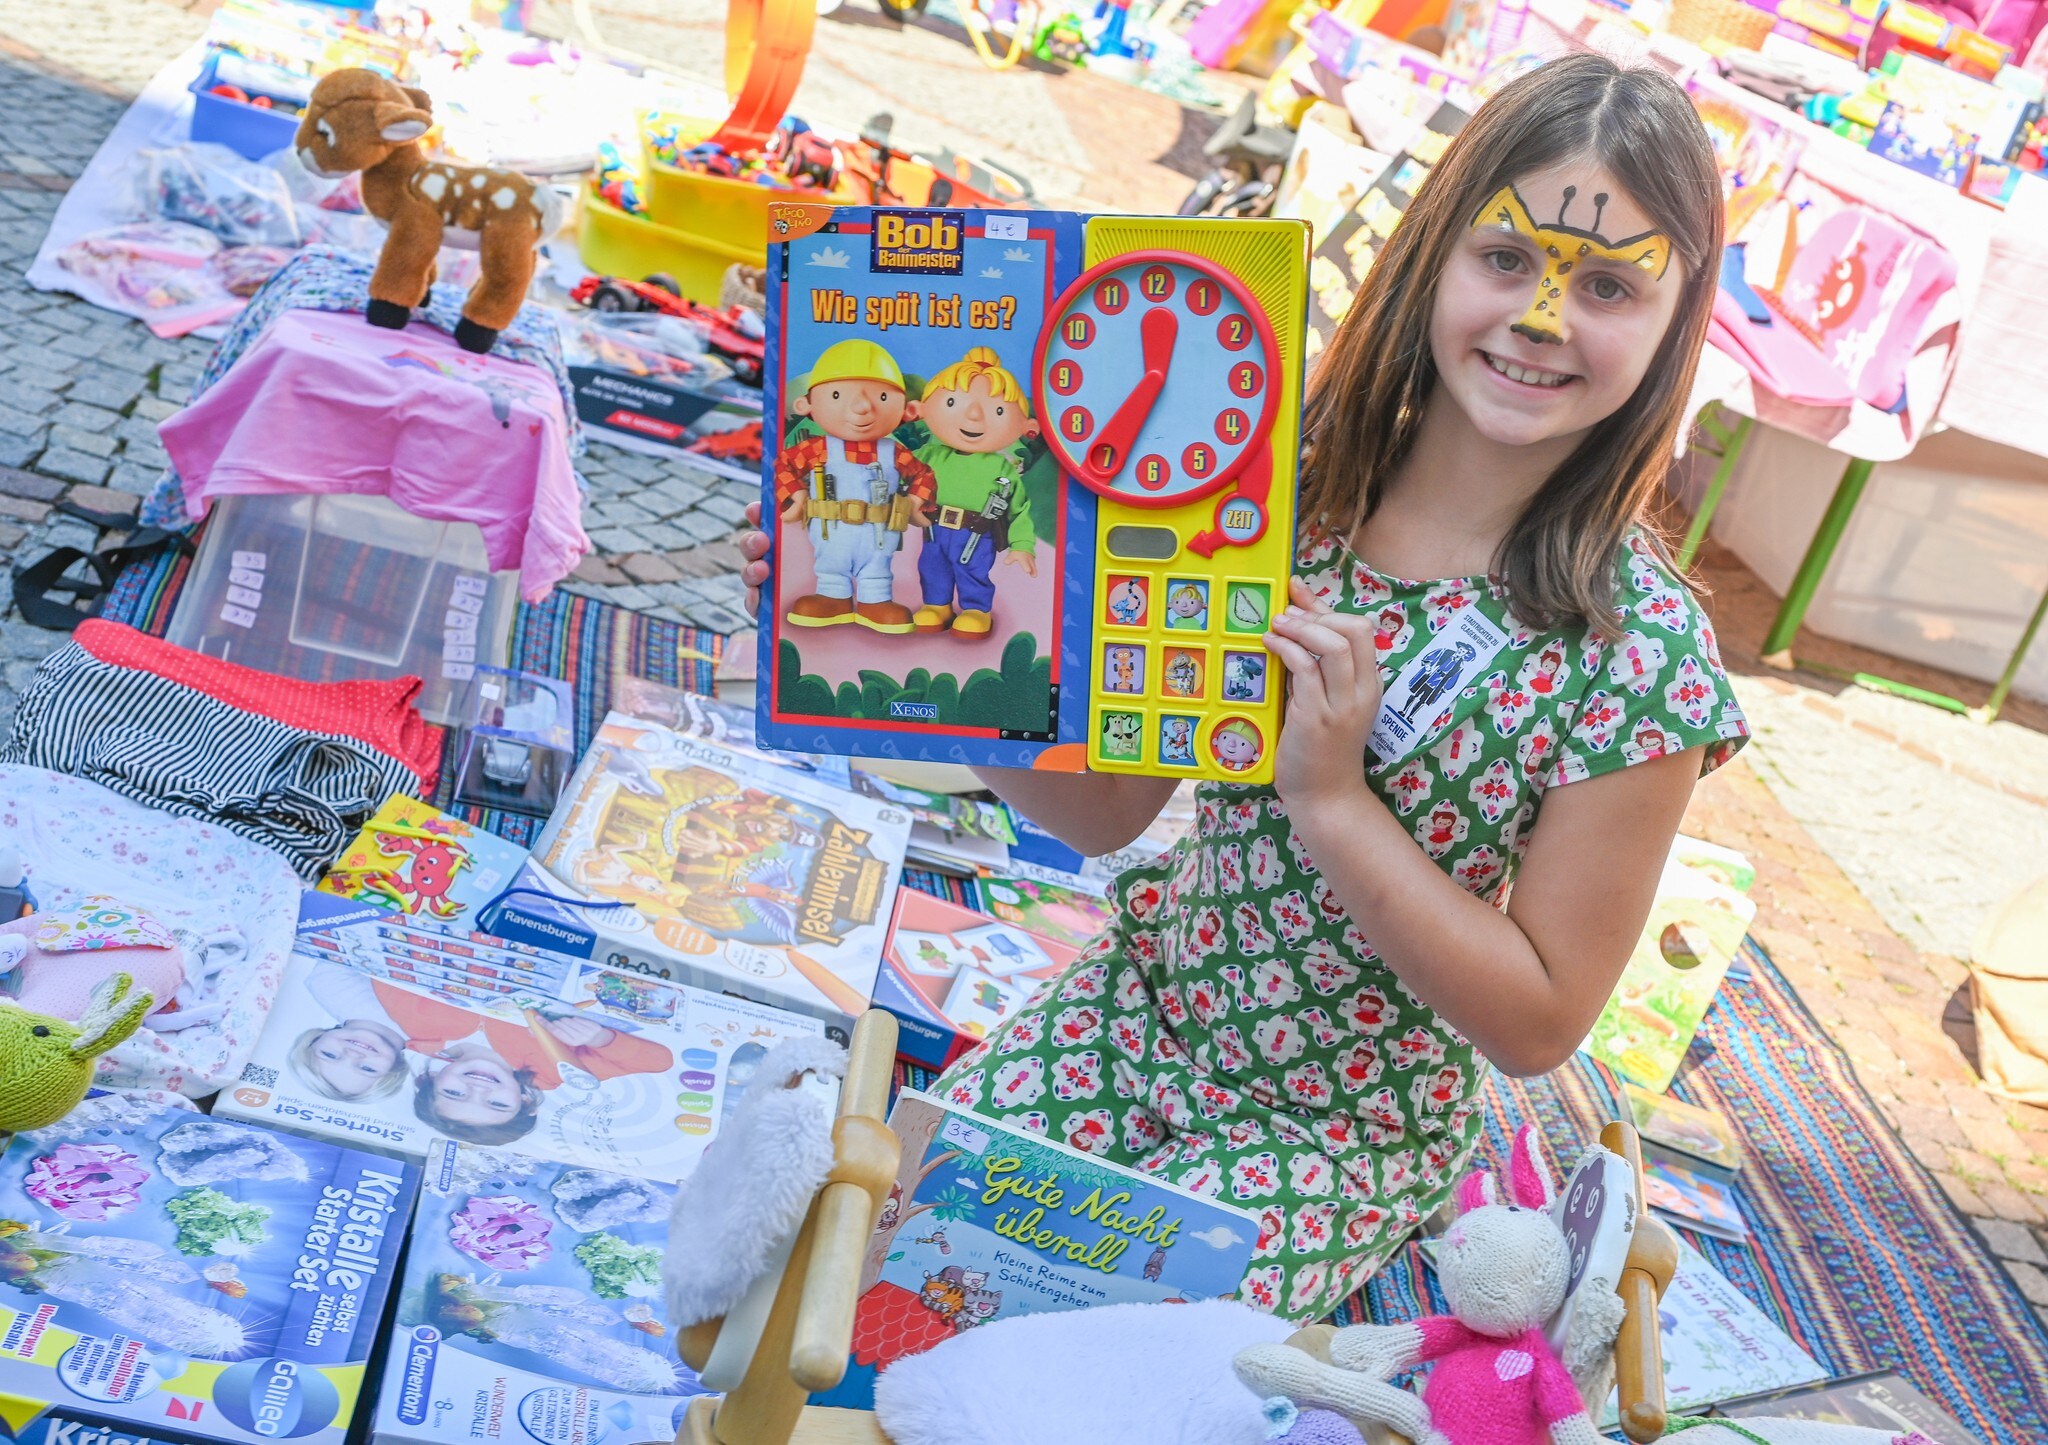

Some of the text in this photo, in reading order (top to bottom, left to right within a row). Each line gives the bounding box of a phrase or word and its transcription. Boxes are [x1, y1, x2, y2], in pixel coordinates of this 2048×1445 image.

[877, 215, 958, 250] Bob
[878, 250, 961, 269] Baumeister
[1146, 273, 1166, 295] 12
[1104, 286, 1120, 306] 11
[1198, 288, 1207, 307] 1
[810, 289, 1018, 332] Wie spät ist es?
[1067, 321, 1086, 342] 10
[1229, 322, 1242, 343] 2
[1058, 367, 1070, 388] 9
[1241, 369, 1252, 390] 3
[592, 376, 674, 406] MECHANICS
[1071, 413, 1082, 433] 8
[1225, 416, 1239, 436] 4
[1102, 446, 1113, 467] 7
[1194, 450, 1205, 471] 5
[1147, 462, 1158, 482] 6
[1225, 509, 1255, 530] ZEIT
[891, 702, 936, 718] XENOS
[1381, 713, 1409, 743] SPENDE
[800, 823, 867, 945] Zahleninsel
[298, 909, 379, 930] Ravensburger
[504, 910, 589, 945] Ravensburger
[897, 1018, 943, 1040] nsburger
[240, 1094, 263, 1104] 4-7
[273, 1103, 404, 1142] Starter-Set
[372, 1117, 395, 1129] und
[947, 1123, 977, 1143] 3€
[981, 1154, 1184, 1248] Gute Nacht
[289, 1185, 352, 1293] Starter Set
[993, 1206, 1130, 1274] überall
[326, 1169, 403, 1333] Kristalle selbst
[993, 1250, 1107, 1299] Kleine Reime zum
[998, 1268, 1090, 1308] Schlafengehen
[2, 1312, 32, 1350] Kristalle
[18, 1304, 57, 1358] Wunderwelt
[304, 1293, 339, 1348] züchten
[68, 1335, 95, 1371] Kristalle
[135, 1361, 150, 1374] Ein
[470, 1389, 489, 1439] KRISTALLE
[487, 1377, 507, 1440] WUNDERWELT
[531, 1394, 545, 1434] KRISTALLE
